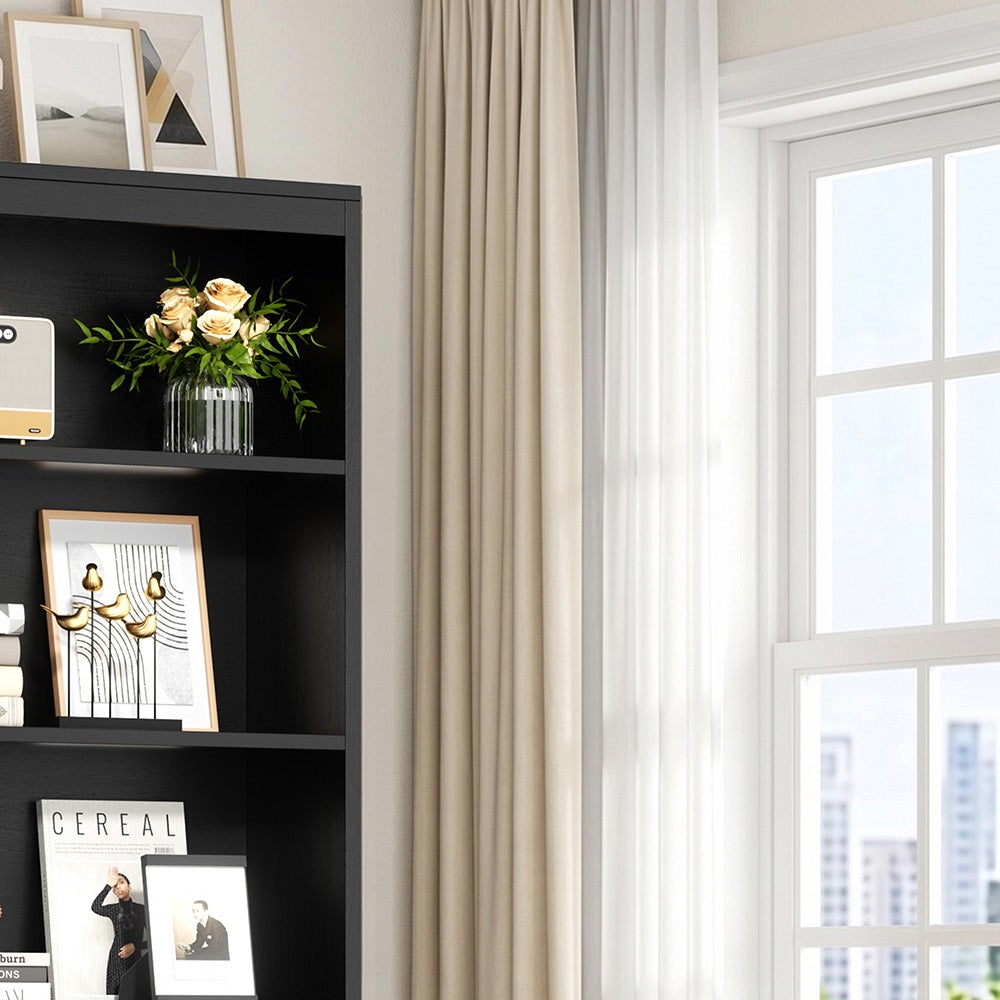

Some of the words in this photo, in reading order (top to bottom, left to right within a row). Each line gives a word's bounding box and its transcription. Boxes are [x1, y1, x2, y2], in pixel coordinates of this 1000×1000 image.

[52, 811, 176, 837] CEREAL
[0, 954, 26, 963] burn
[3, 990, 24, 1000] AM
